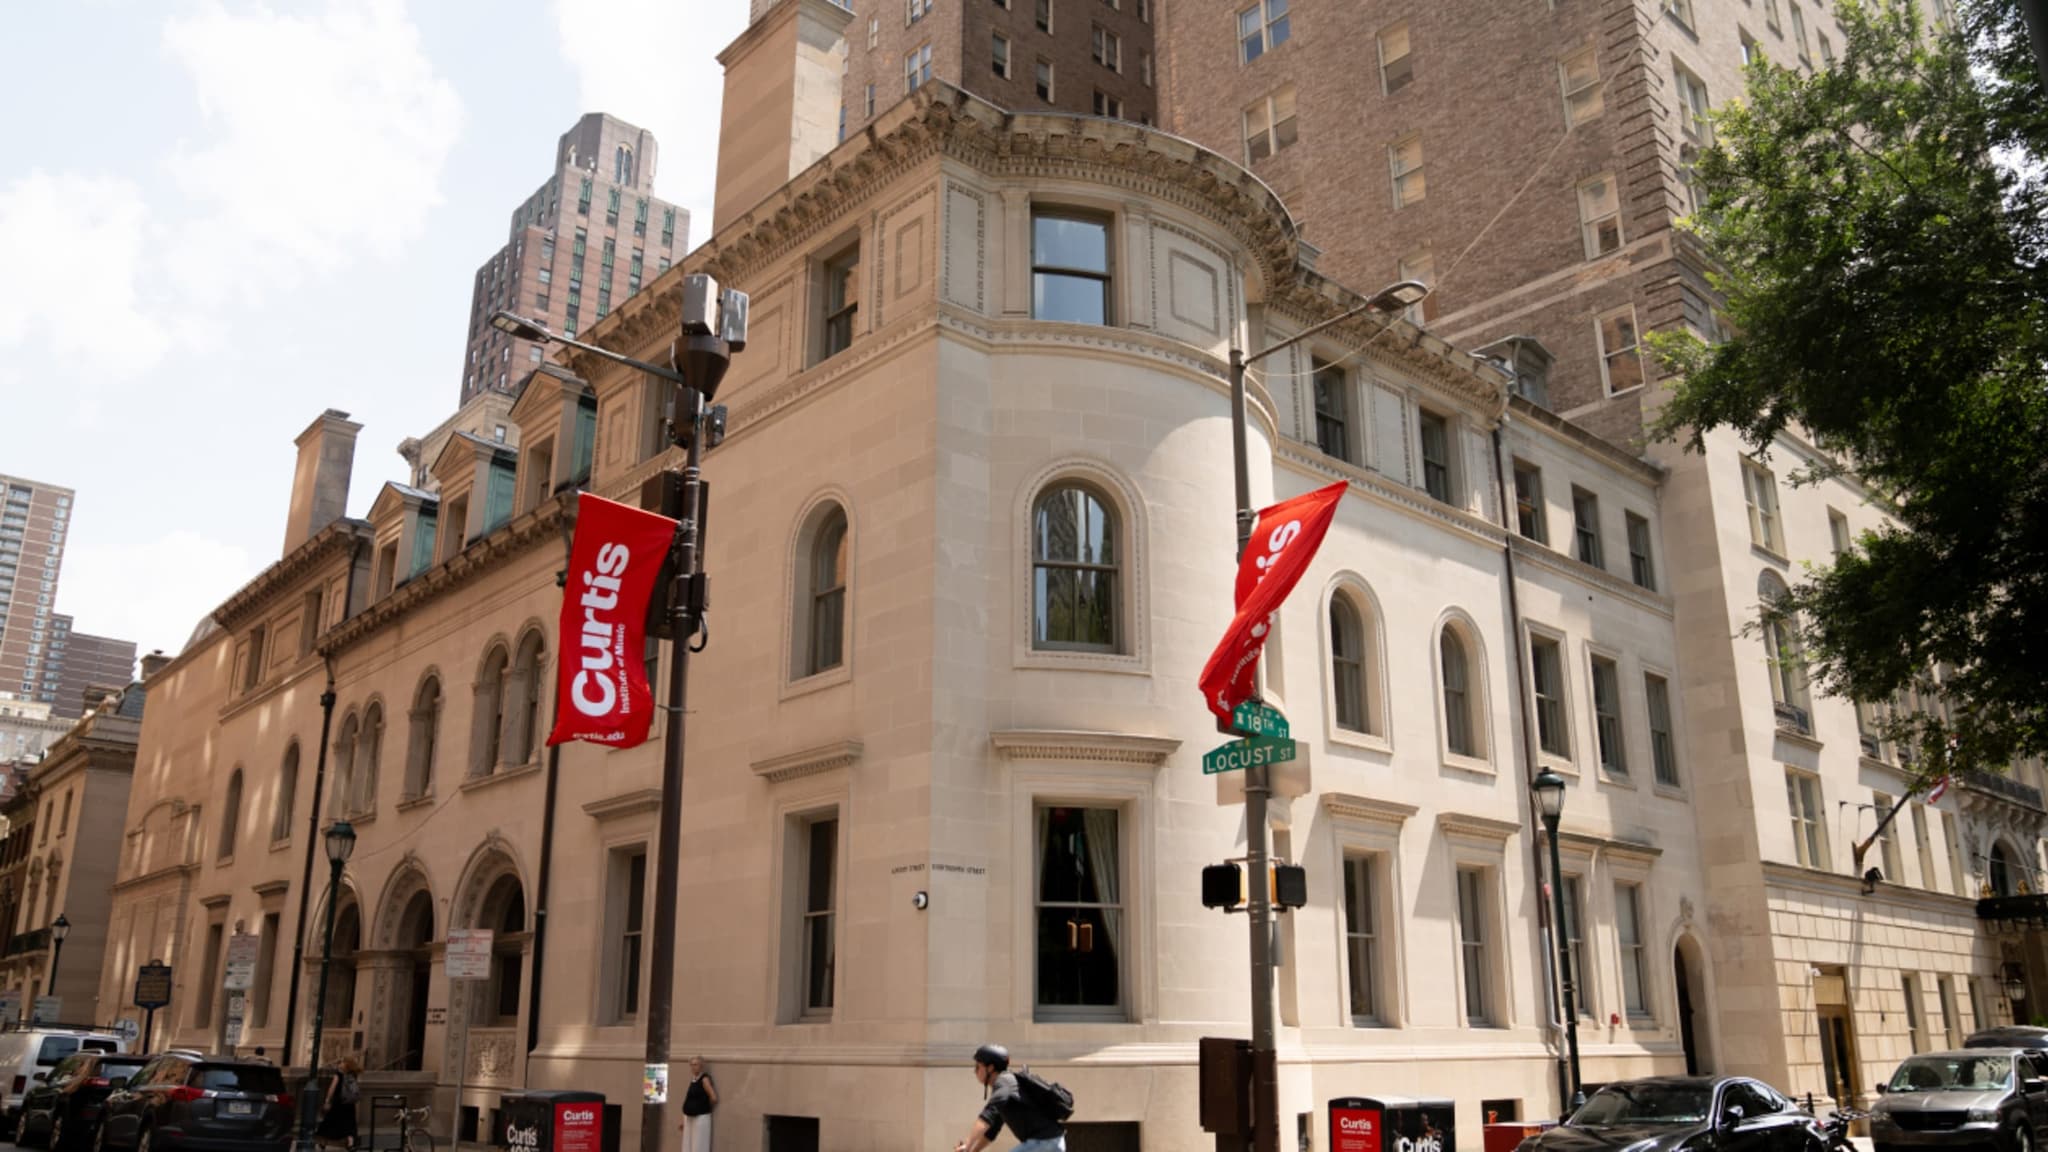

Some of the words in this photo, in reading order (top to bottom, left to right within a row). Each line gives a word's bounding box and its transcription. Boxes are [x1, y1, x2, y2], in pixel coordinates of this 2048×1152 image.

[571, 542, 630, 717] Curtis
[615, 624, 625, 656] Music
[615, 671, 630, 714] Institute
[1247, 713, 1274, 733] 18TH
[1278, 728, 1287, 739] ST
[1206, 745, 1274, 772] LOCUST
[1279, 747, 1292, 761] ST
[563, 1110, 594, 1121] Curtis
[1340, 1117, 1372, 1130] Curtis
[506, 1124, 537, 1147] Curtis
[1399, 1136, 1441, 1152] Curtis
